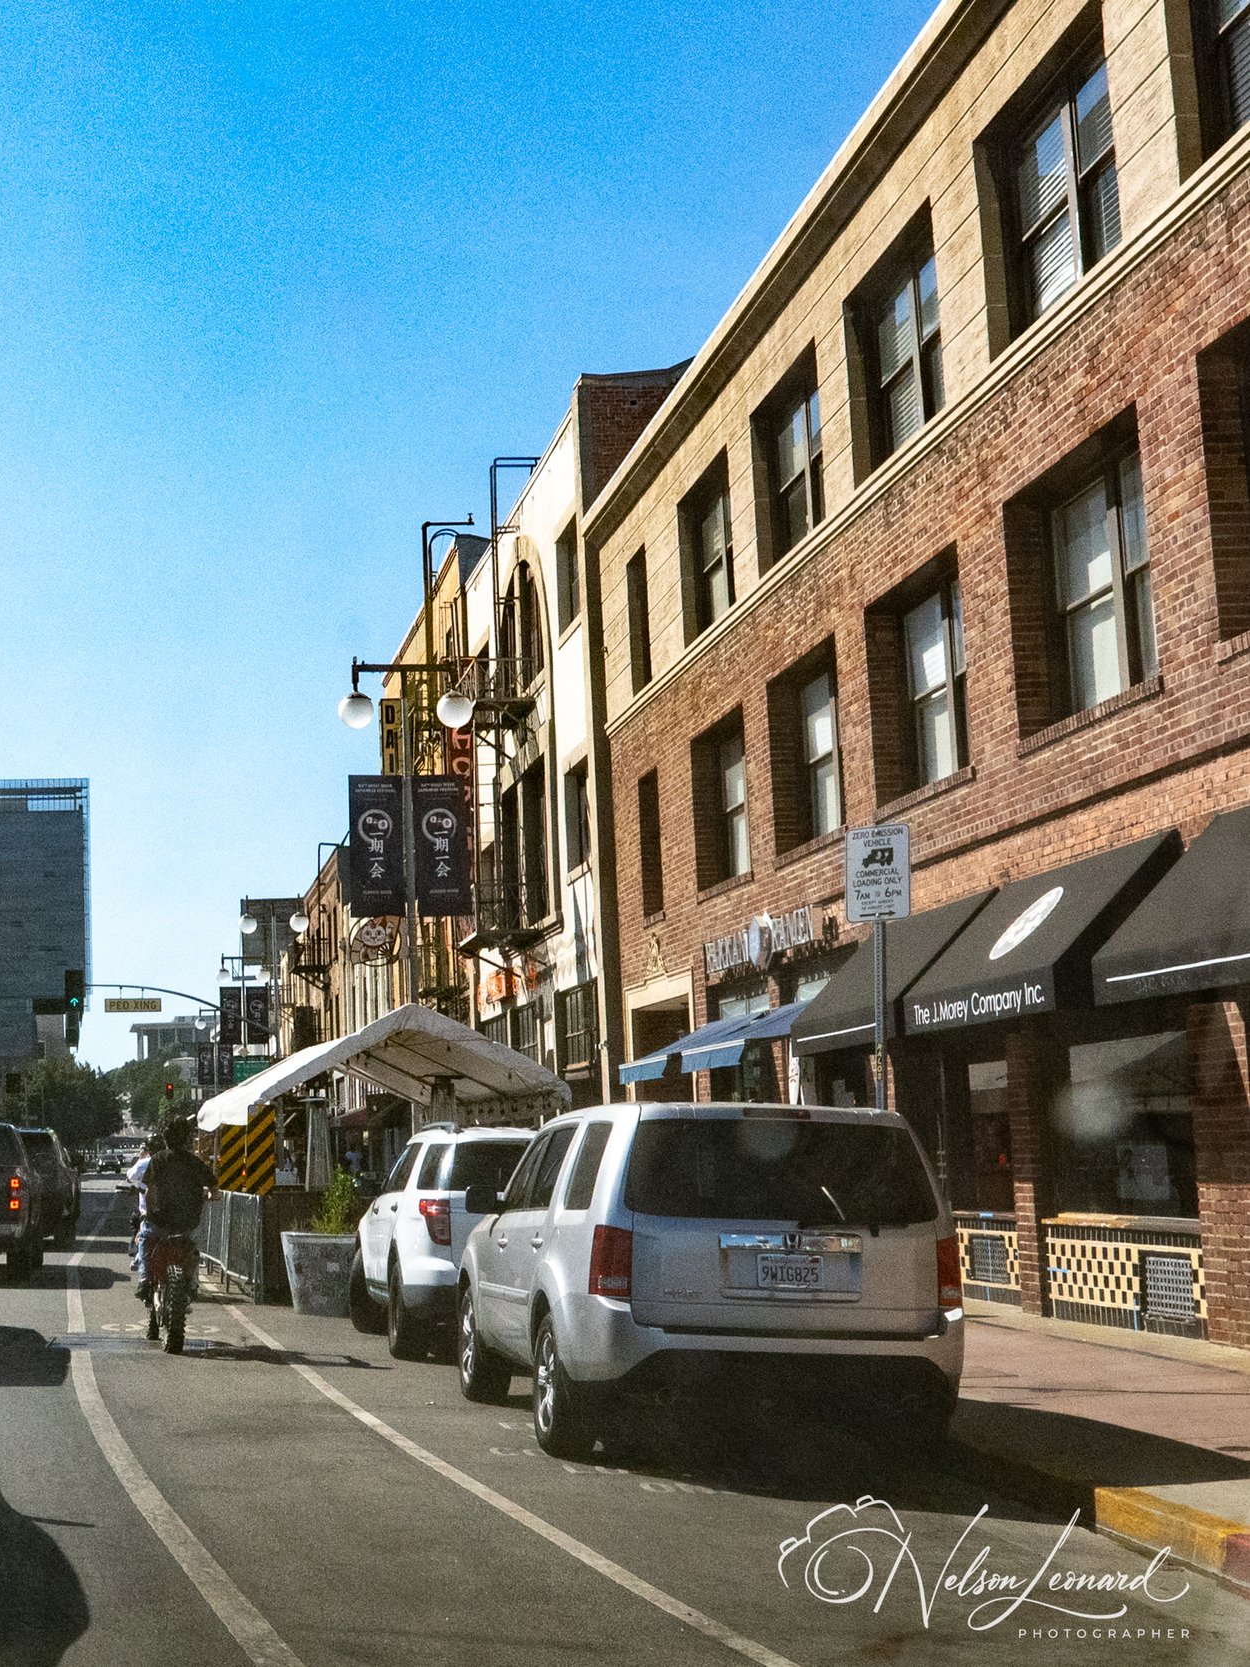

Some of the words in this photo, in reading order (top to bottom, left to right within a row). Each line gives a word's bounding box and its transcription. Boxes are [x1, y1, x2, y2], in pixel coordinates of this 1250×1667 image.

[852, 831, 869, 840] ZERO
[871, 828, 904, 838] EMISSION
[863, 838, 892, 848] VEHICLE
[369, 831, 386, 879] 一期一会
[433, 830, 451, 878] 一期一会
[855, 868, 899, 879] COMMERCIAL
[853, 878, 883, 888] LOADING
[884, 875, 902, 885] ONLY
[854, 889, 871, 900] 7AM
[884, 887, 902, 898] 6PM
[705, 929, 749, 973] RAKKAN
[109, 1001, 130, 1010] PED
[133, 1000, 157, 1010] XING
[913, 1004, 930, 1025] The
[971, 989, 1022, 1016] Company
[1024, 982, 1045, 1005] Inc.
[762, 1266, 819, 1283] 9WIG825
